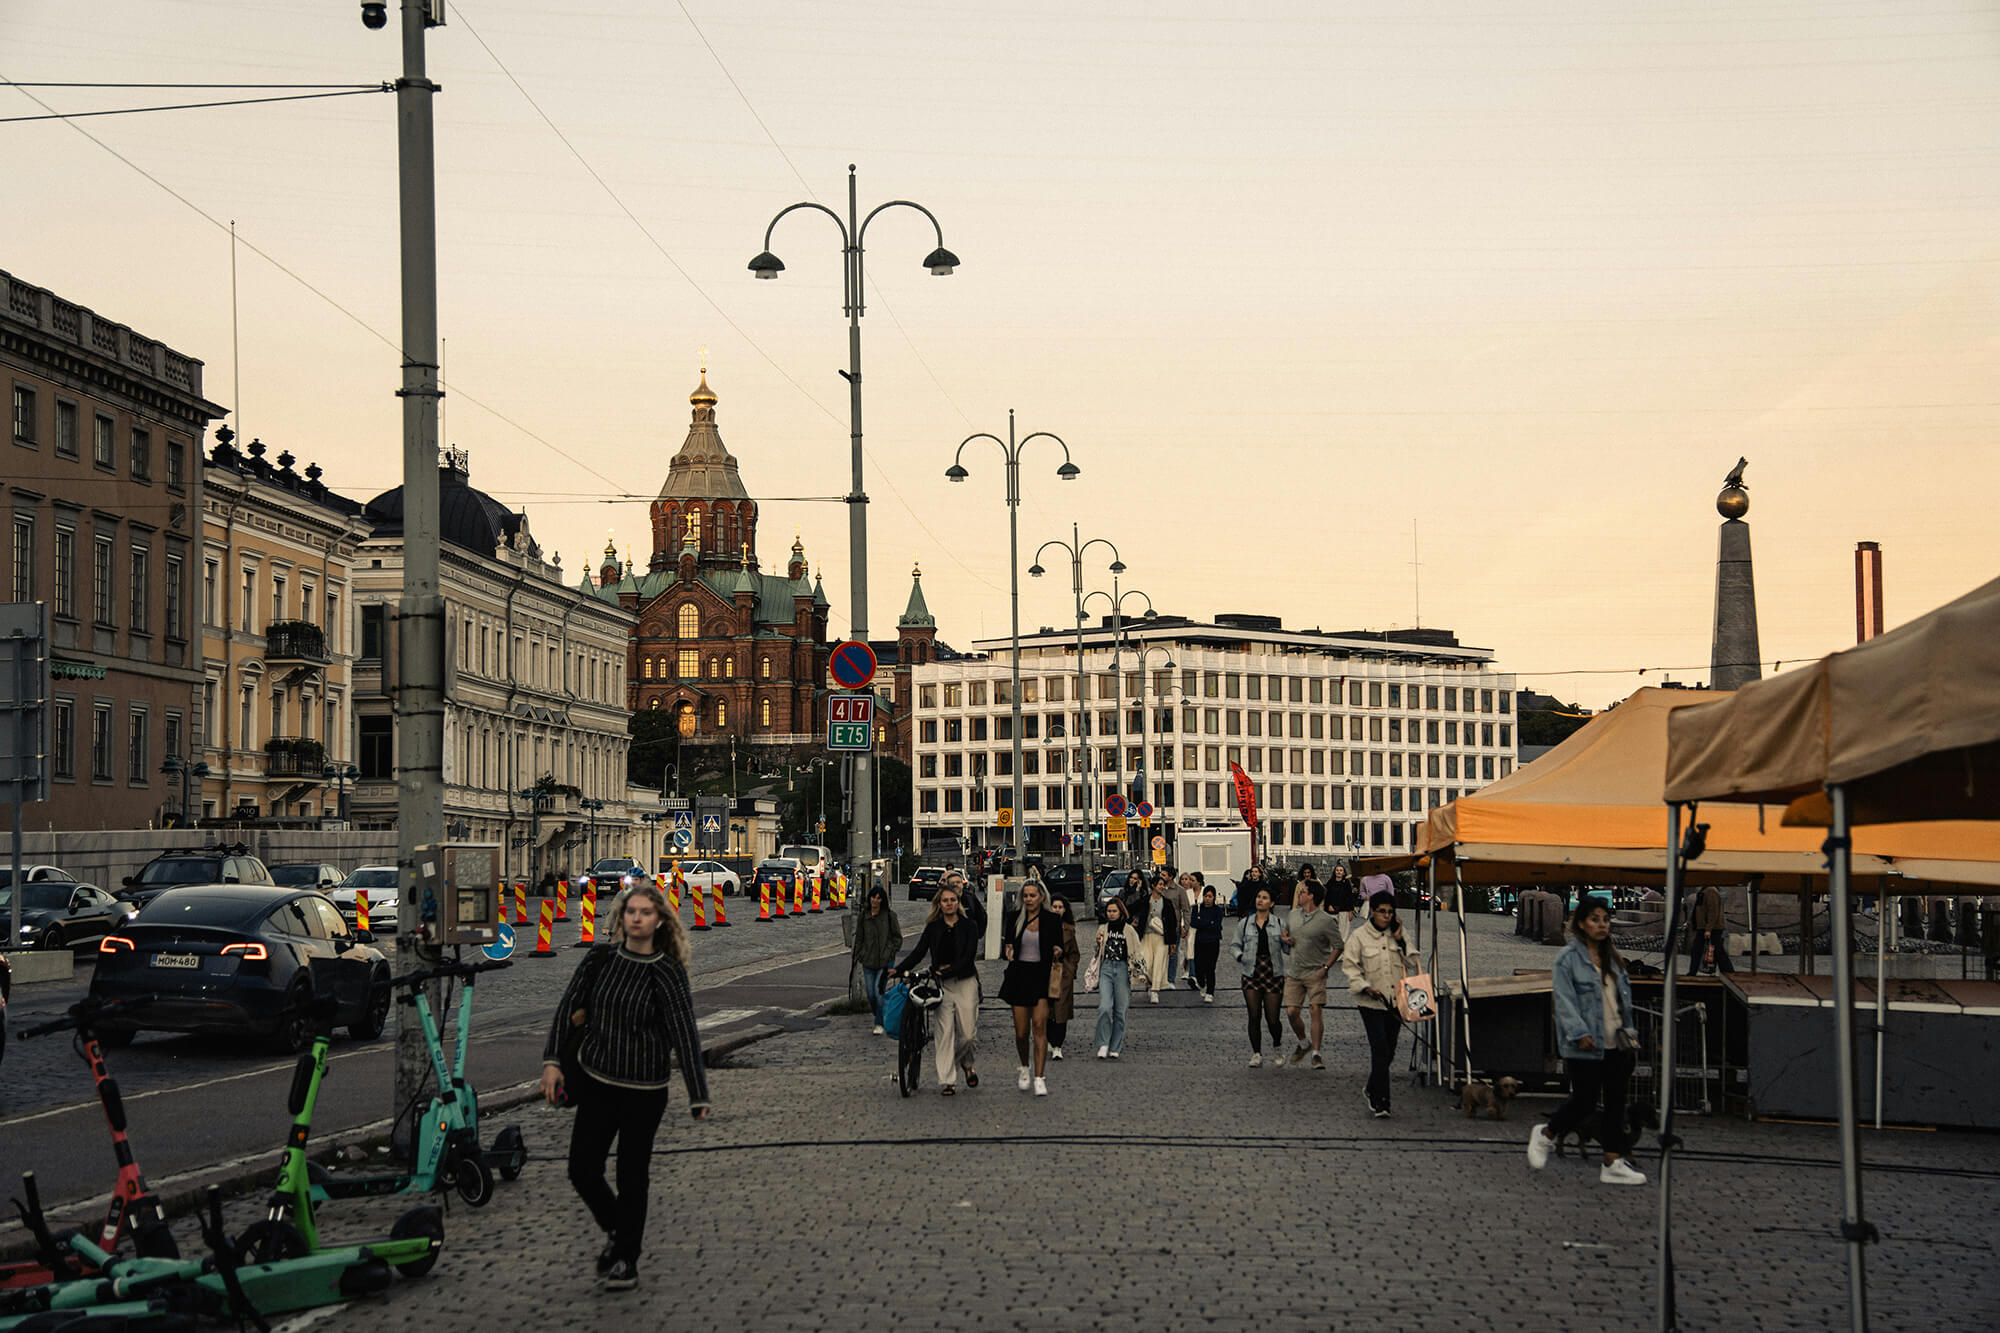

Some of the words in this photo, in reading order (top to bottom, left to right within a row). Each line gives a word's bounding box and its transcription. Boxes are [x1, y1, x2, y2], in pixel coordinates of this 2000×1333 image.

[836, 702, 845, 719] 4
[857, 702, 865, 719] 7
[835, 727, 844, 743] E
[847, 727, 864, 743] 75
[157, 956, 196, 967] MOM-480
[427, 1135, 443, 1167] TIER
